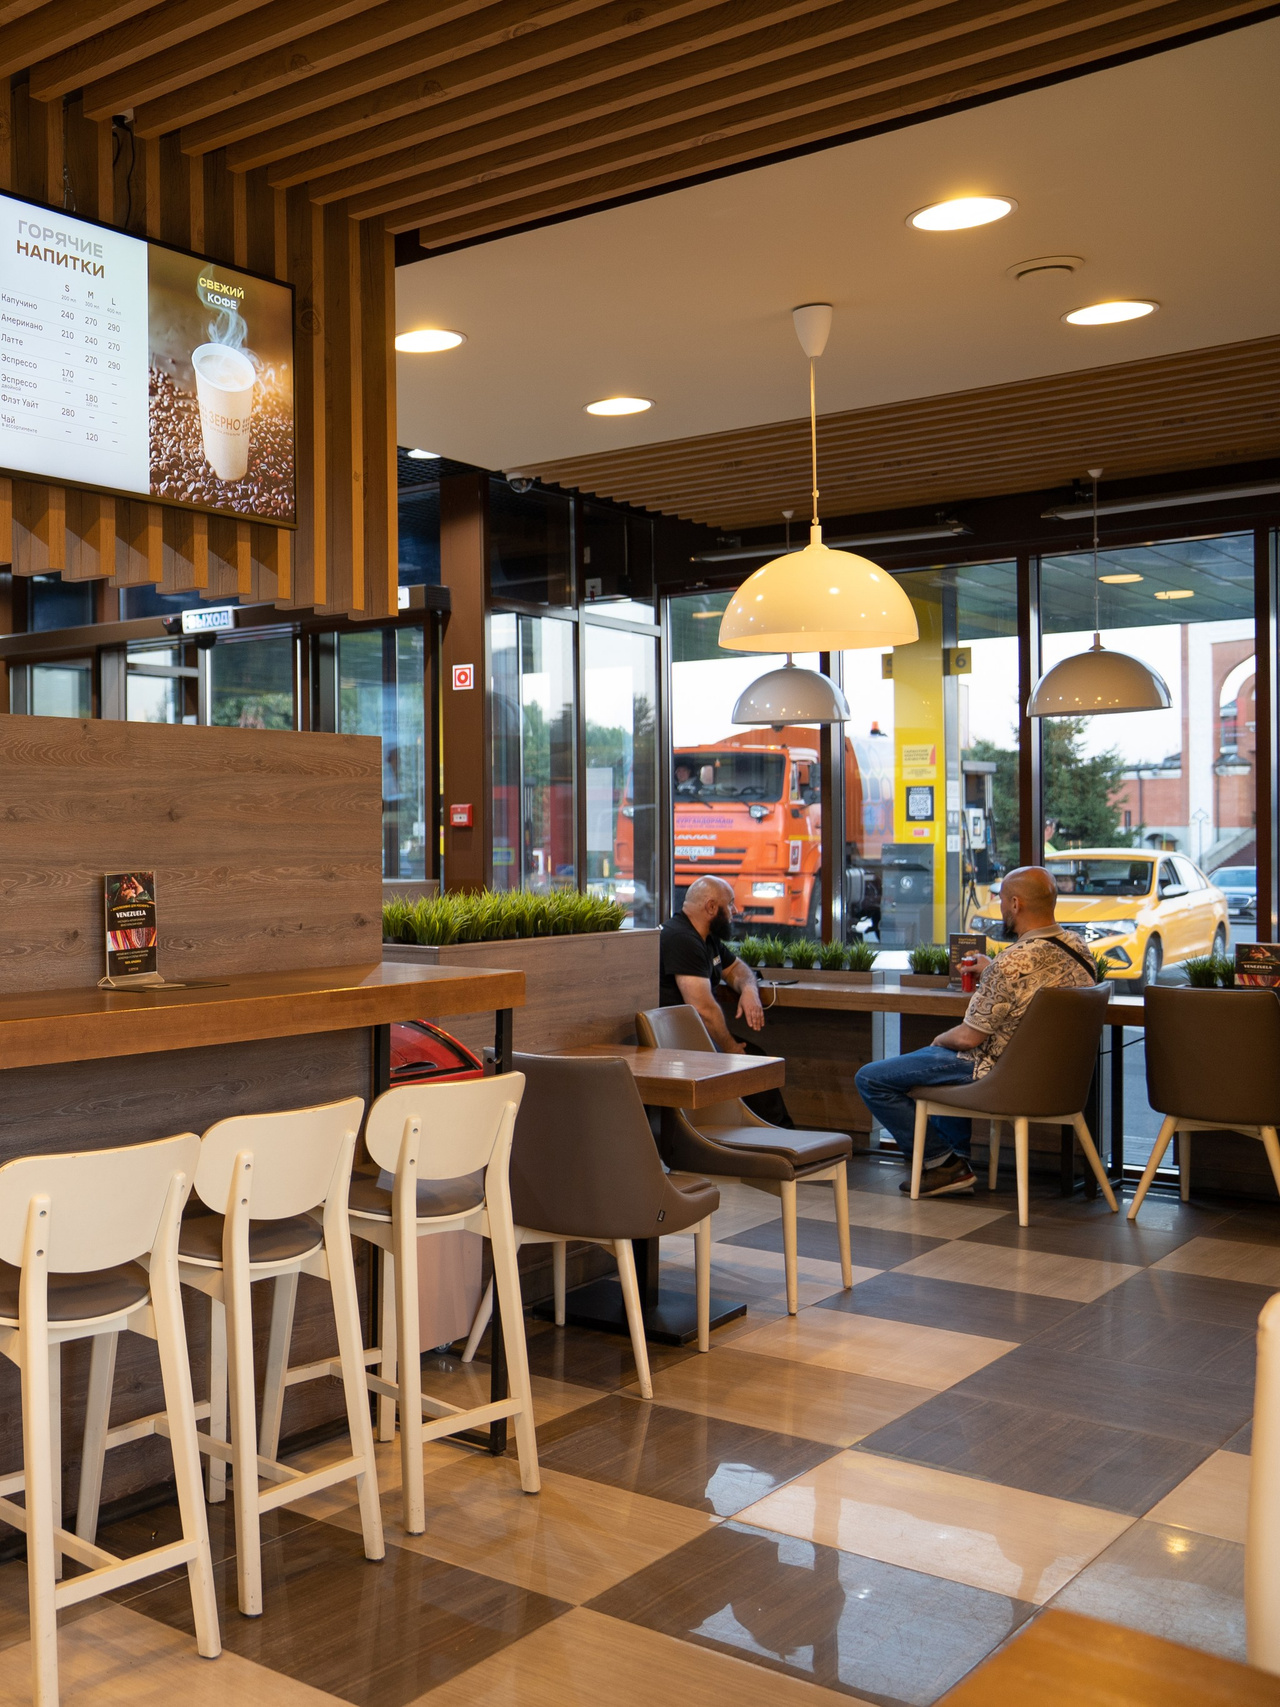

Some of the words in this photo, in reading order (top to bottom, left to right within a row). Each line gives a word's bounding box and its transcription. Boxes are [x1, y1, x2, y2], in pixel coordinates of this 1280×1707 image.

[18, 220, 103, 258] ГОРЯЧИЕ
[17, 240, 104, 279] НАПИТКИ
[64, 284, 70, 293] S
[111, 298, 116, 306] L
[199, 277, 245, 300] СВЕЖИЙ
[207, 293, 237, 310] КОФЕ
[1, 293, 38, 310] Капучино
[60, 310, 75, 320] 240
[85, 317, 98, 327] 270
[107, 323, 121, 333] 290
[1, 313, 44, 331] Американо
[61, 330, 74, 340] 210
[84, 336, 98, 346] 240
[108, 342, 120, 352] 270
[1, 333, 24, 346] Латте
[85, 355, 98, 365] 270
[107, 361, 121, 371] 290
[1, 353, 38, 370] Эспрессо
[61, 369, 74, 379] 170
[1, 373, 38, 389] Эспрессо
[85, 394, 98, 403] 180
[1, 394, 21, 405] Флэт
[21, 398, 39, 409] Уайт
[61, 408, 76, 418] 280
[1, 413, 16, 424] Чай
[85, 432, 99, 442] 120
[209, 411, 241, 431] ЗЕРНО
[955, 653, 967, 669] 6
[116, 910, 146, 918] VENEZUELA
